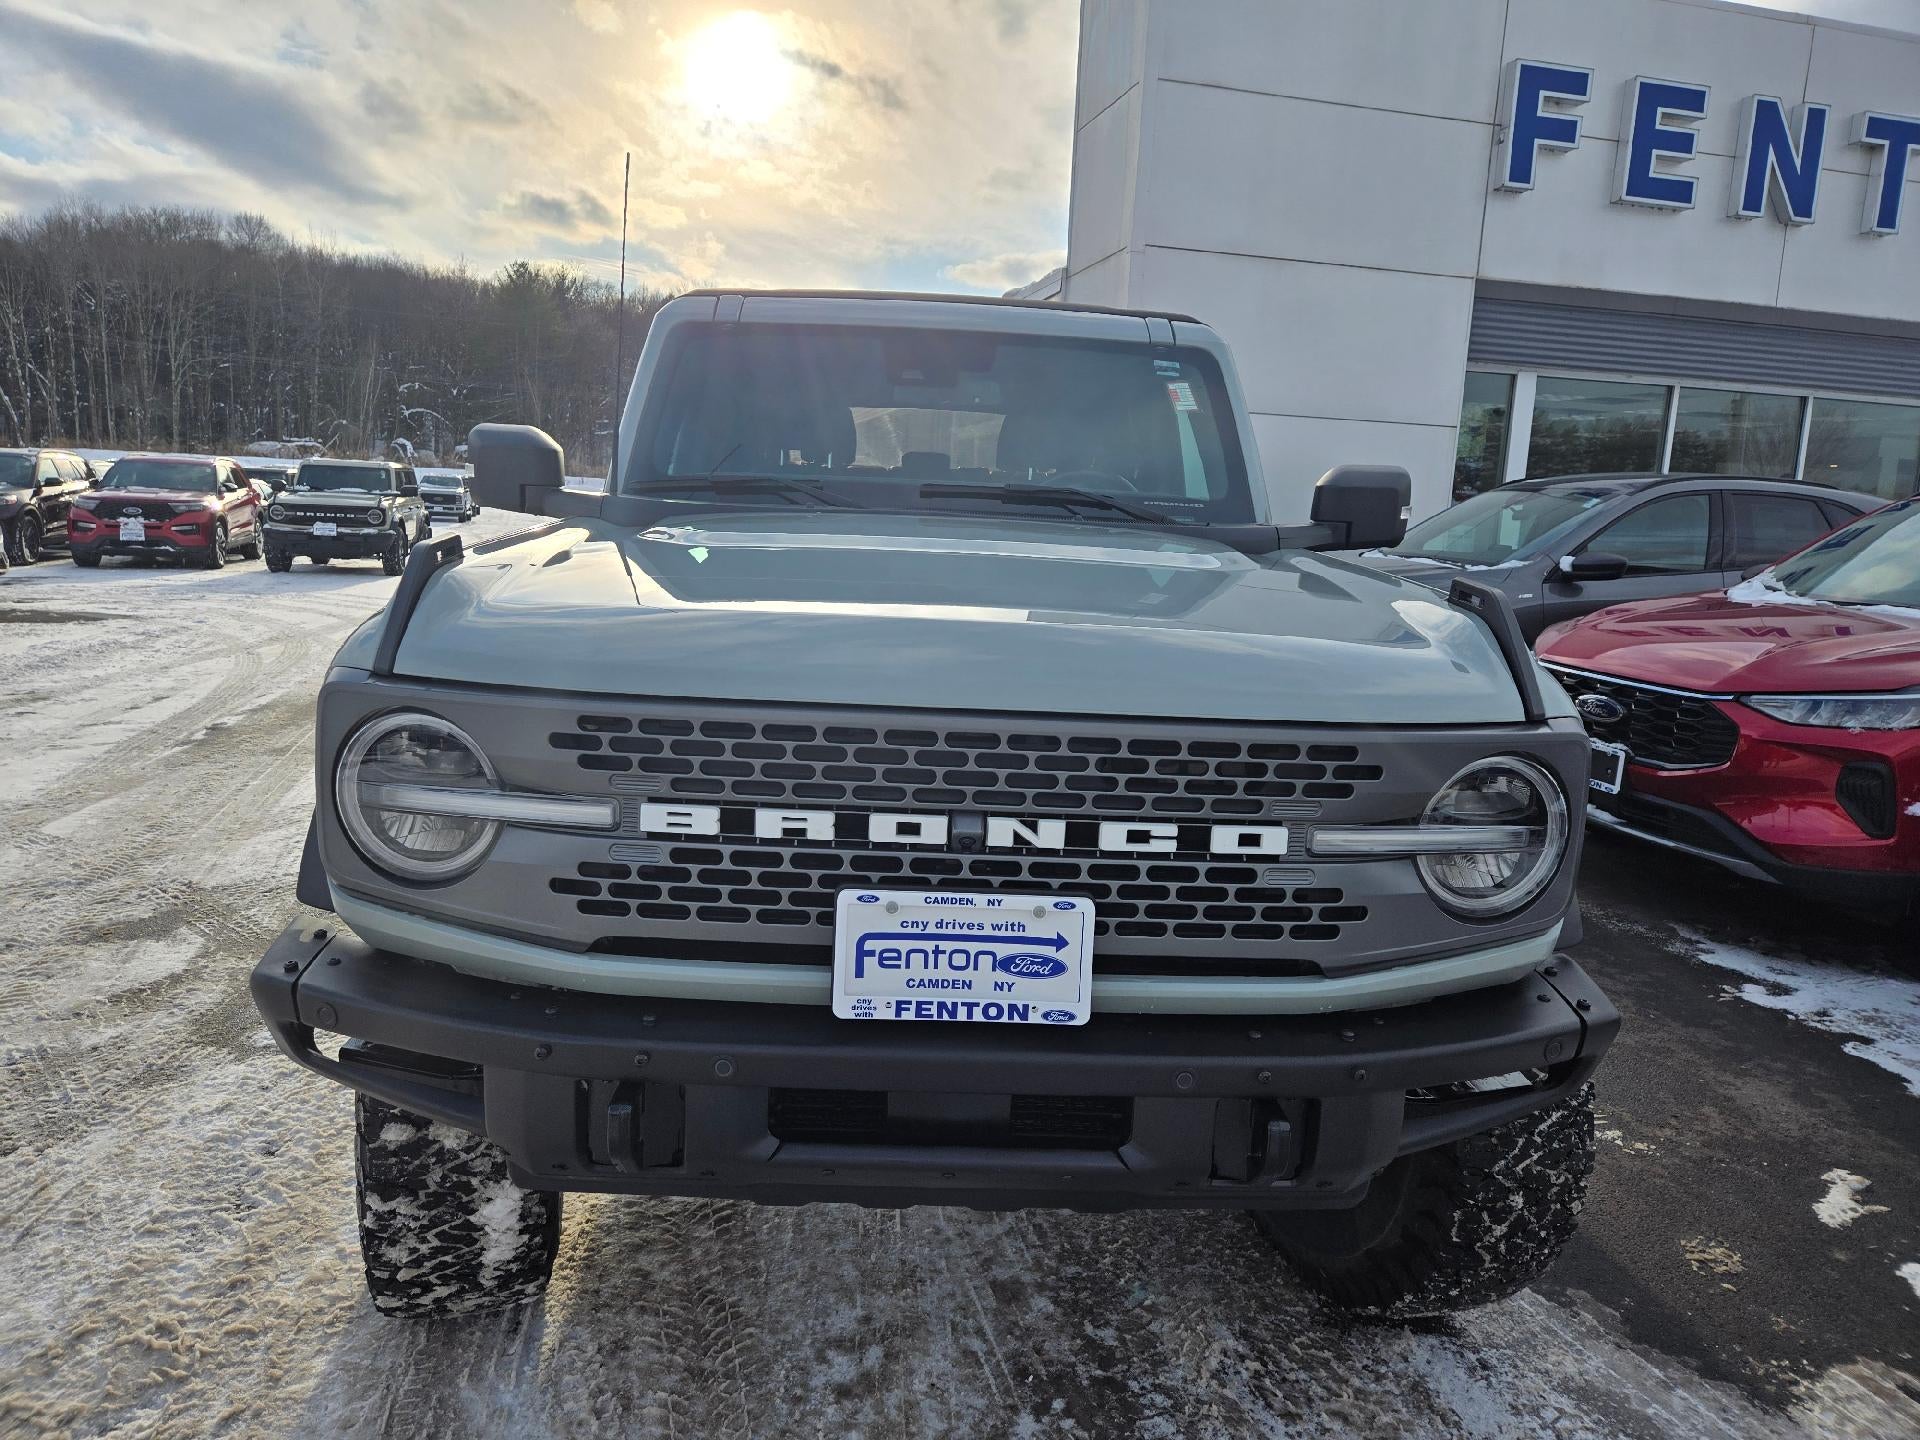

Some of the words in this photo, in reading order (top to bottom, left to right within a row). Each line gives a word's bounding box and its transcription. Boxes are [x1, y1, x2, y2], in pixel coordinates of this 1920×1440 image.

[640, 802, 1289, 855] BRONCO
[923, 896, 977, 908] CAMDEN,
[987, 898, 1004, 907] NY
[900, 920, 929, 932] cny
[934, 918, 985, 931] drives
[990, 920, 1026, 933] with
[905, 977, 972, 990] CAMDEN
[993, 980, 1016, 993] NY
[856, 998, 873, 1006] cny
[894, 999, 1030, 1022] FENTON
